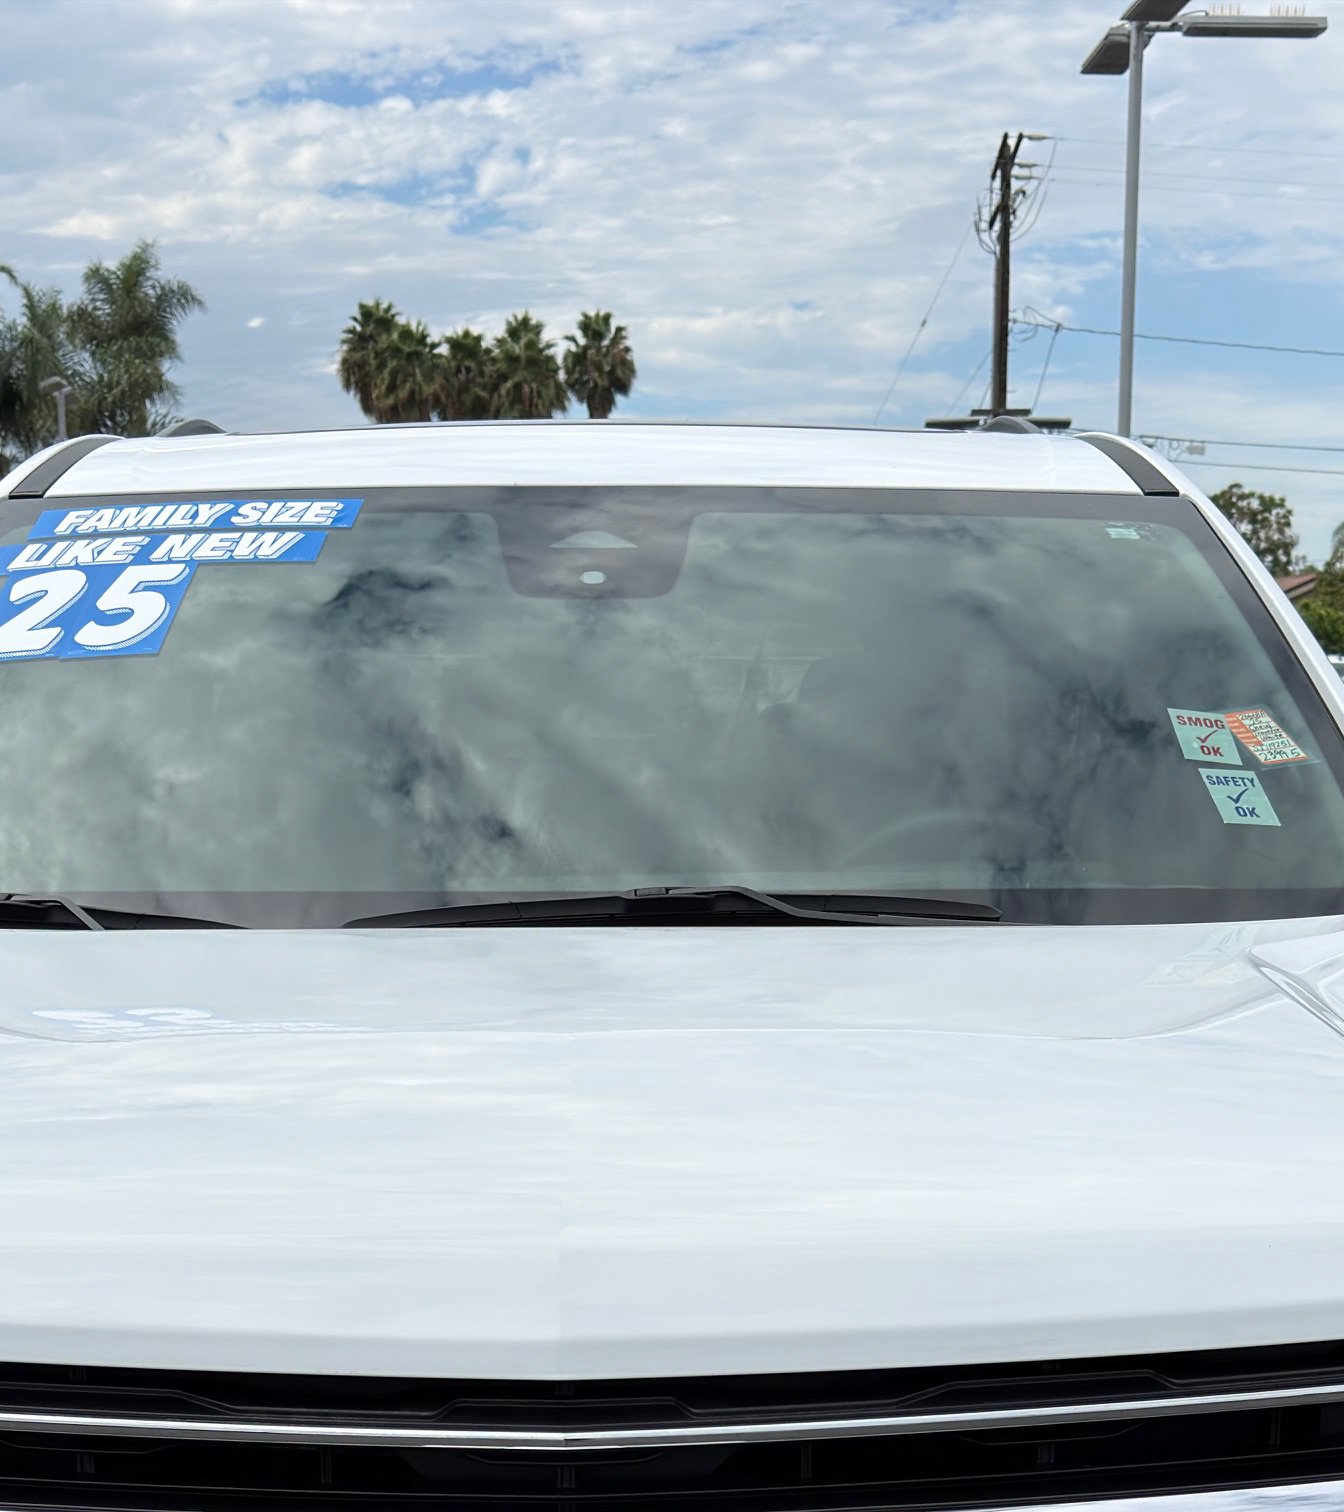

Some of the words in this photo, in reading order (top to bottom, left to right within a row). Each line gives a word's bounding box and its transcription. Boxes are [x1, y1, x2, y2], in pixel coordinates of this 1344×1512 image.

[54, 502, 234, 534] FAMILY
[231, 500, 344, 526] SIZE
[7, 534, 150, 572] LIKE
[151, 531, 305, 562] NEW
[1176, 715, 1225, 729] SMOG
[1200, 745, 1224, 757] OK
[1206, 775, 1255, 788] SAFETY
[1235, 806, 1260, 818] OK
